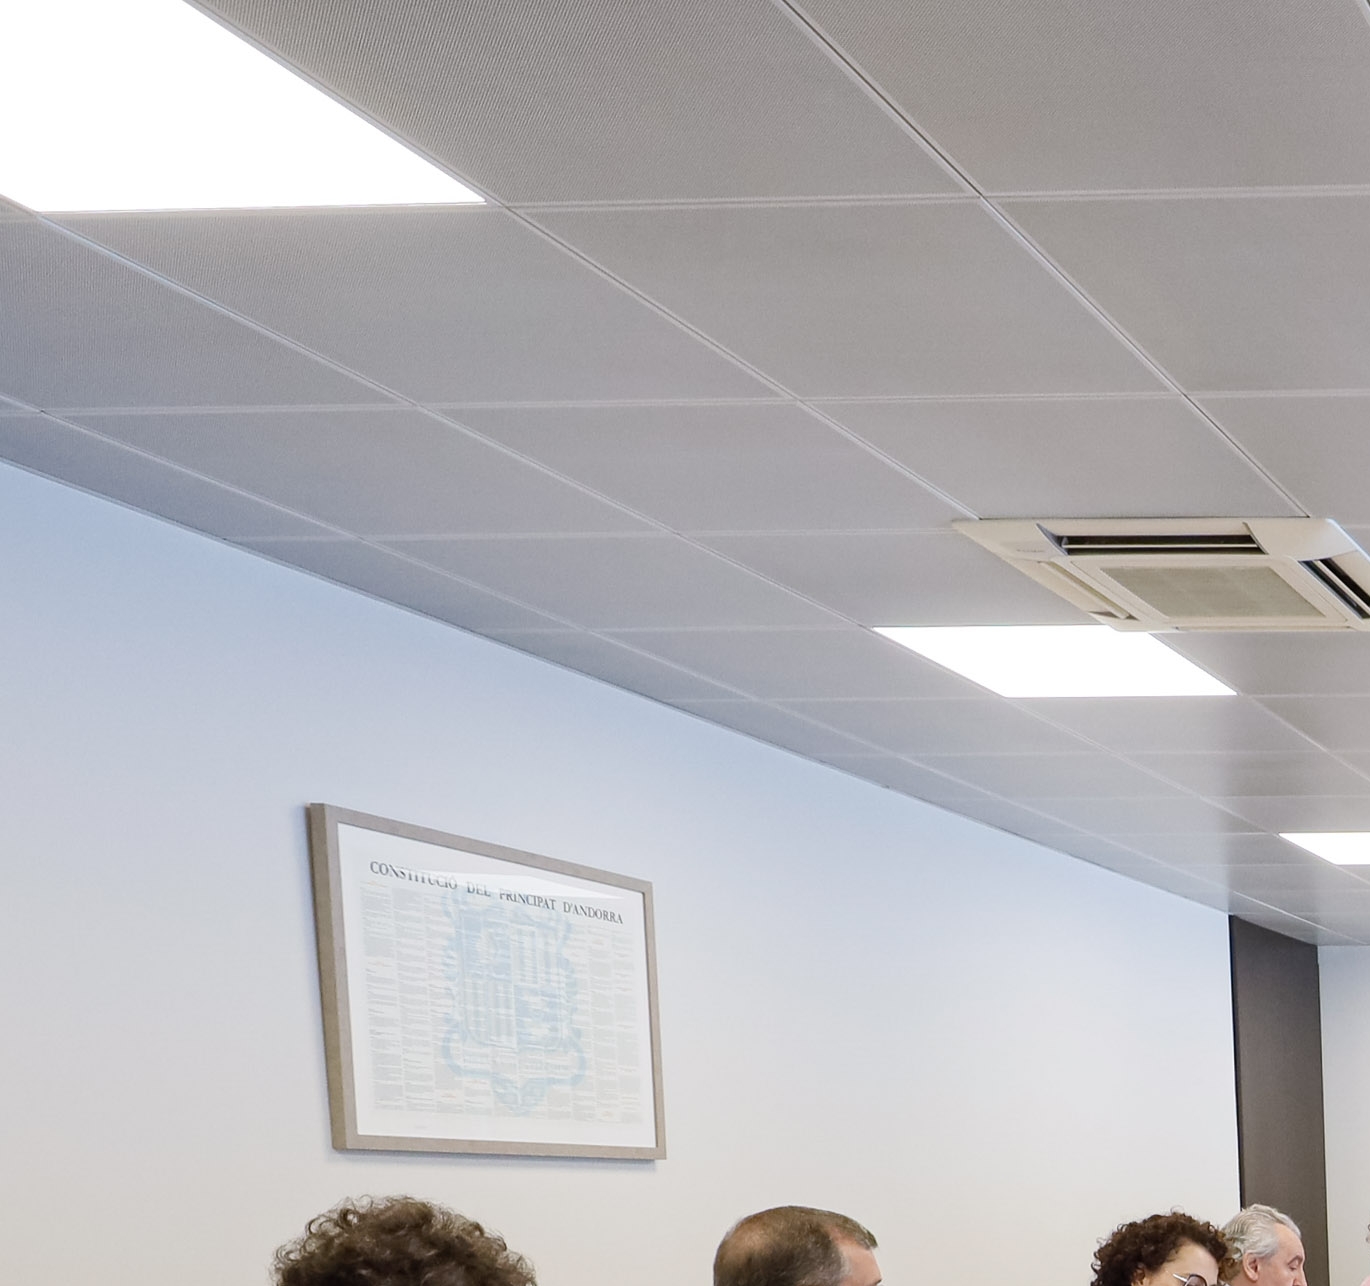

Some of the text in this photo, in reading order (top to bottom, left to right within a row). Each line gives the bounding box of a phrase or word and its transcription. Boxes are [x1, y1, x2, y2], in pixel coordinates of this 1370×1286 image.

[466, 880, 491, 897] DEL
[499, 891, 556, 911] PRINCIPAT
[563, 902, 624, 925] D'ANDORRA
